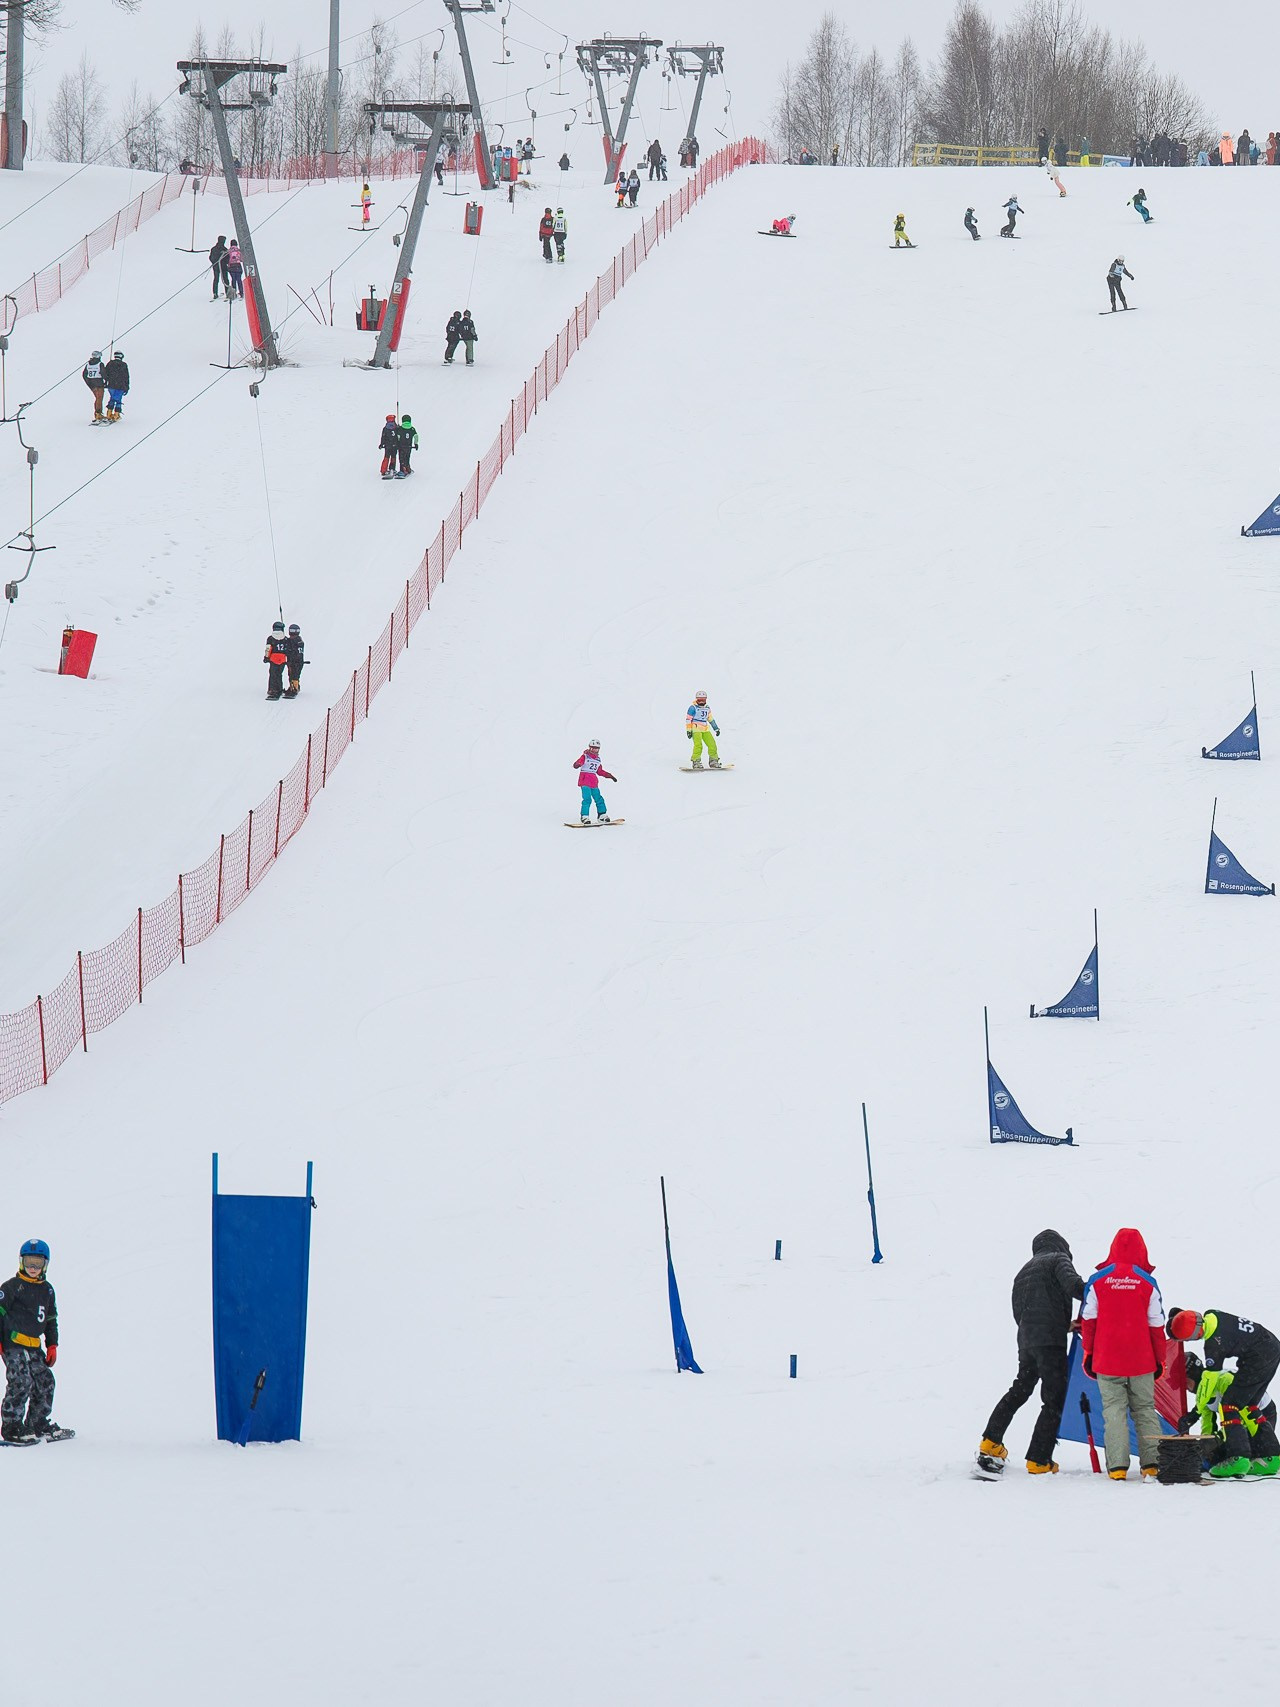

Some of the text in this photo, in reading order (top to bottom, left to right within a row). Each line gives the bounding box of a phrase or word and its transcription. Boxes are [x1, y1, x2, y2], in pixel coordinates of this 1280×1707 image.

[394, 283, 401, 292] 2
[88, 370, 97, 378] 87
[276, 643, 285, 651] 12
[1219, 750, 1259, 759] Rosengineering
[589, 762, 598, 771] 23
[1049, 1004, 1098, 1015] Rosengineerin
[37, 1305, 46, 1323] 5
[1238, 1317, 1255, 1334] 53
